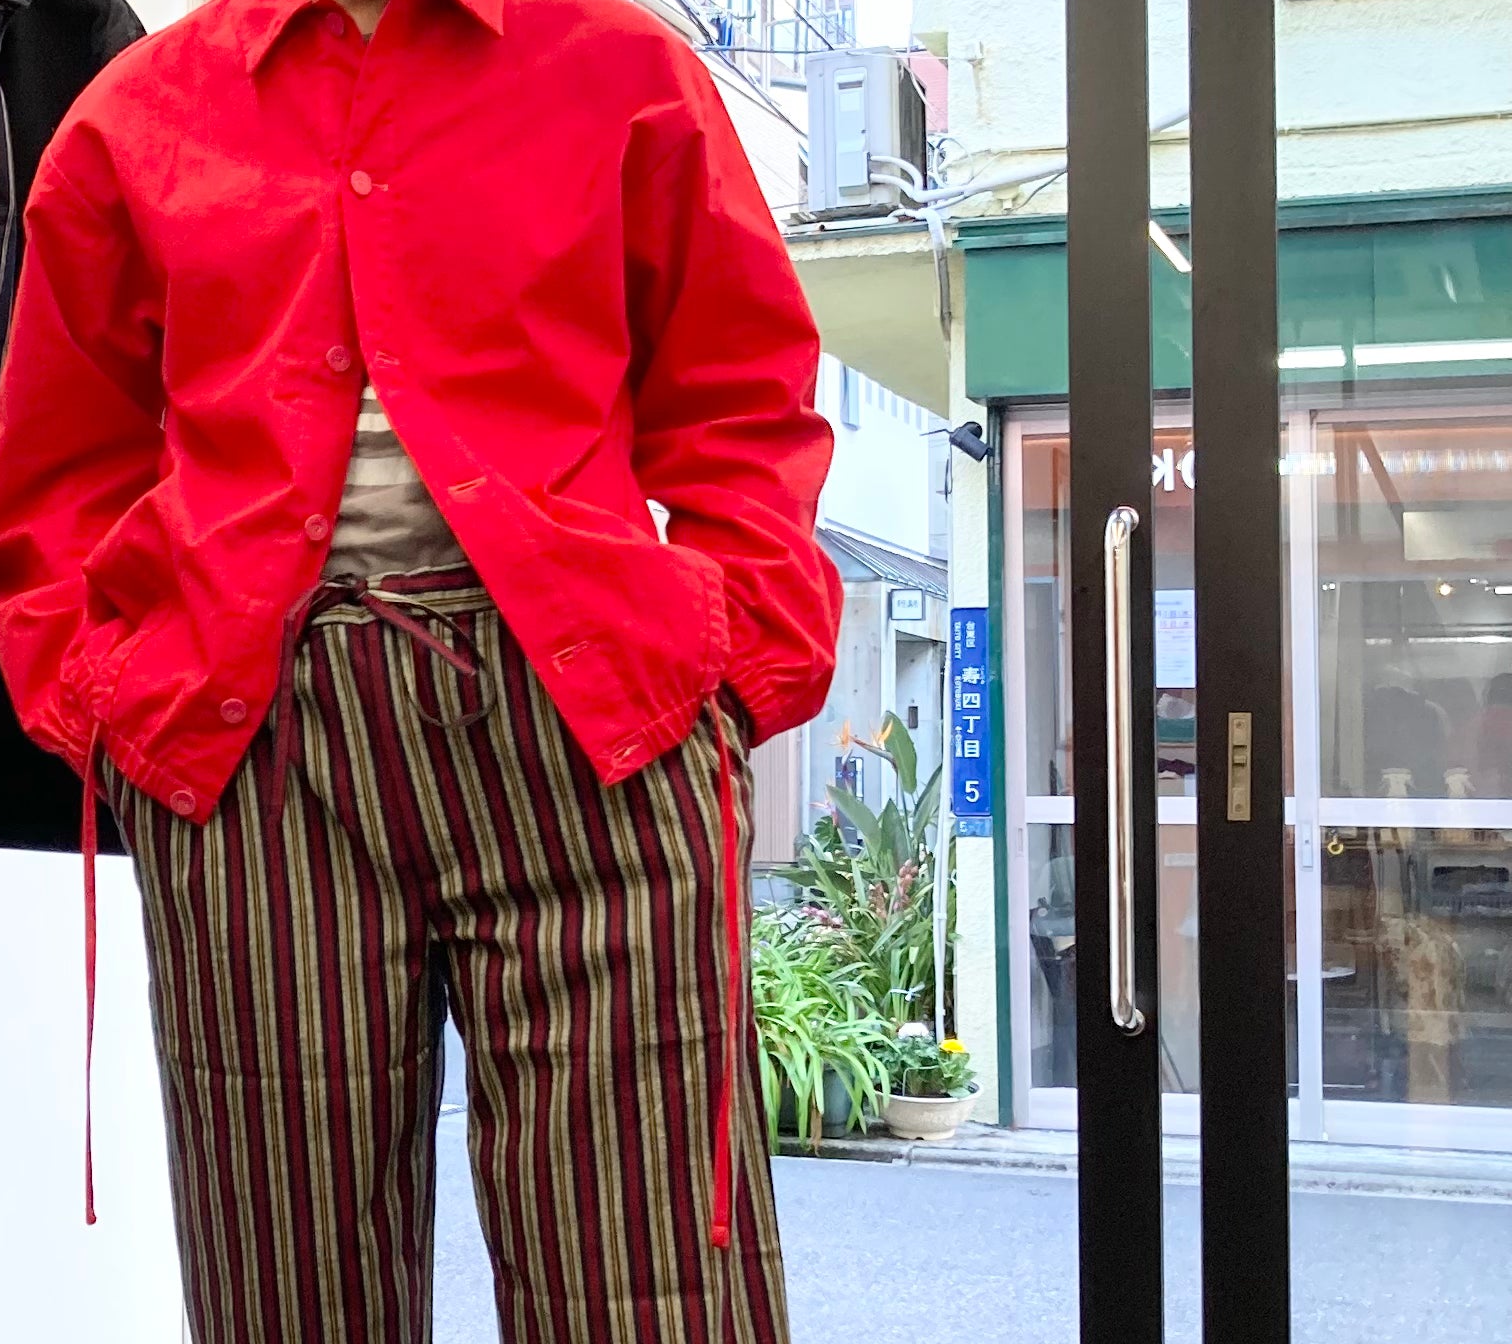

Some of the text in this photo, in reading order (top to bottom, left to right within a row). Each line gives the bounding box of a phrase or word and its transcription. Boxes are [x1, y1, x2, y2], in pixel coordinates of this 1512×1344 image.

[961, 667, 981, 758] 寿四丁目
[965, 780, 980, 803] 5
